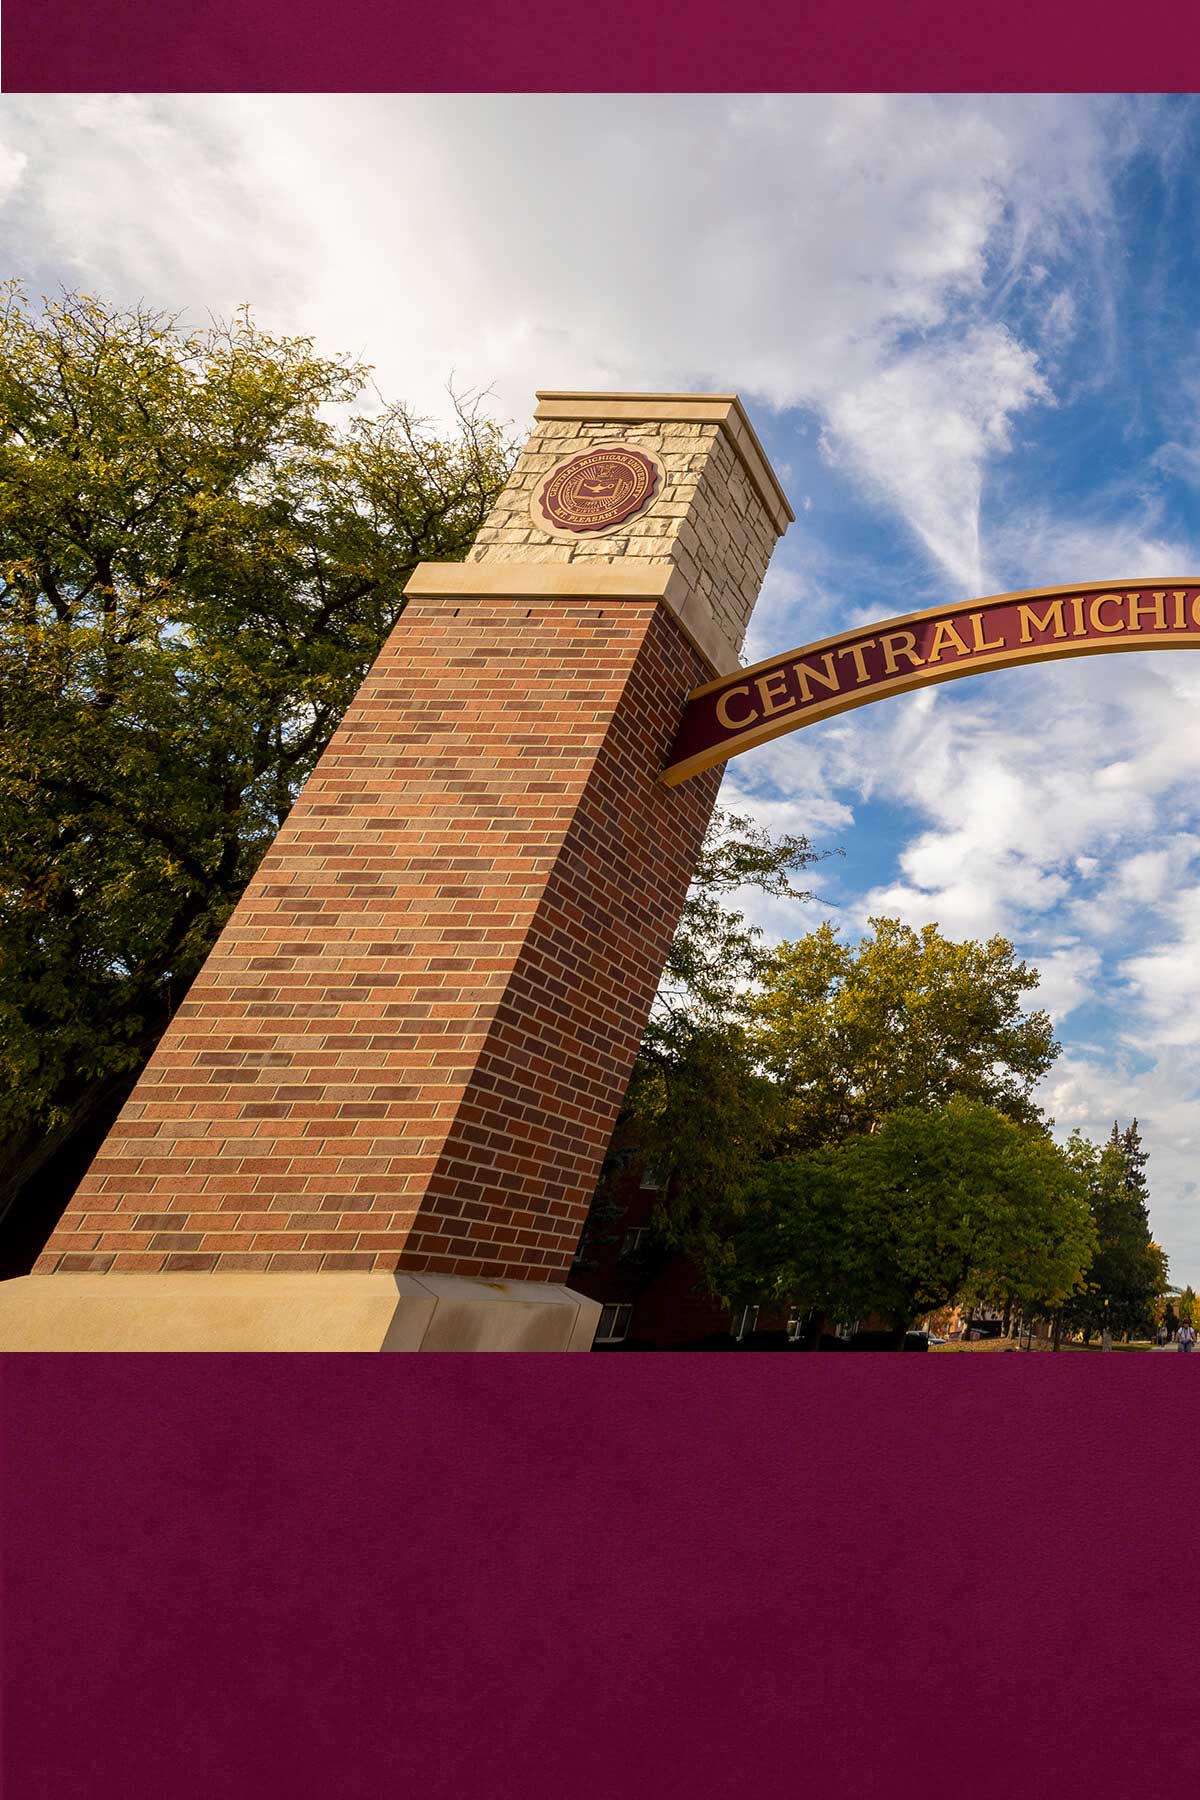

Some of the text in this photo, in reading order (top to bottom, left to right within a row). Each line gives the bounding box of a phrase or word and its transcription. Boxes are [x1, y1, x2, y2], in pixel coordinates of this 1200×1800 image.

[550, 465, 578, 497] CENTRAL
[579, 454, 627, 467] MICHIGAN
[627, 458, 646, 498] UNIVERSITY
[568, 509, 619, 523] PLEASANT
[715, 612, 1005, 730] CENTRAL
